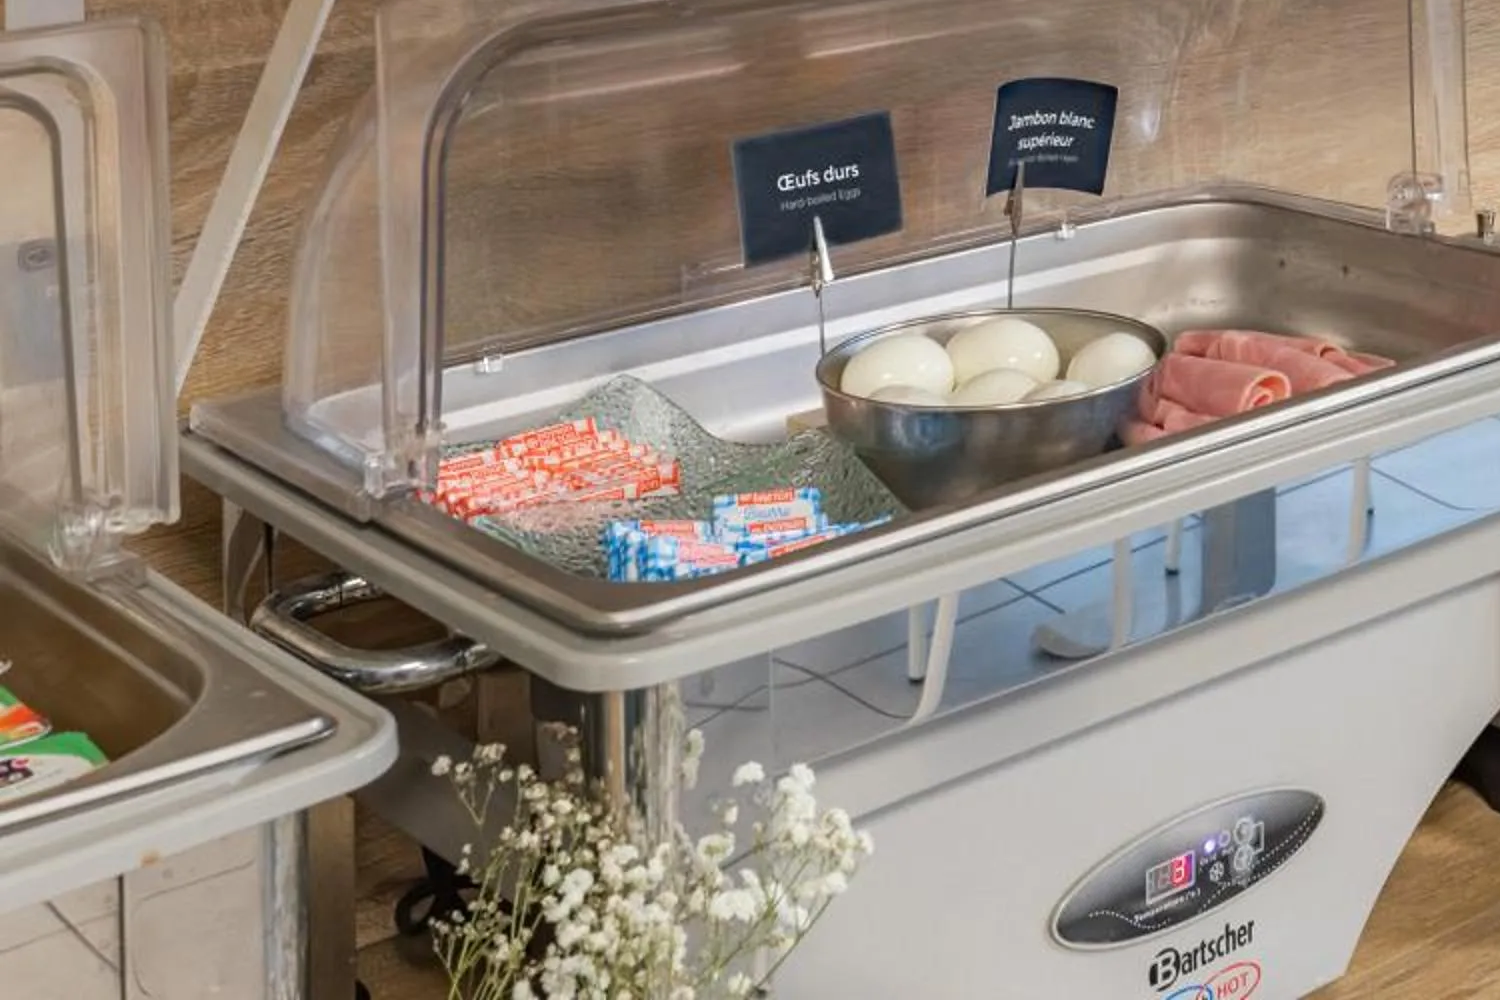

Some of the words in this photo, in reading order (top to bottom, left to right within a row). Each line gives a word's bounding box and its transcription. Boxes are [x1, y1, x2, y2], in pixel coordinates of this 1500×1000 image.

[1007, 110, 1058, 131] Jambon
[1058, 110, 1096, 131] blanc
[1017, 134, 1075, 152] supérieur
[776, 167, 821, 193] Œufs
[823, 163, 861, 185] durs
[1149, 920, 1255, 992] Bartscher
[1216, 971, 1249, 999] HOT
